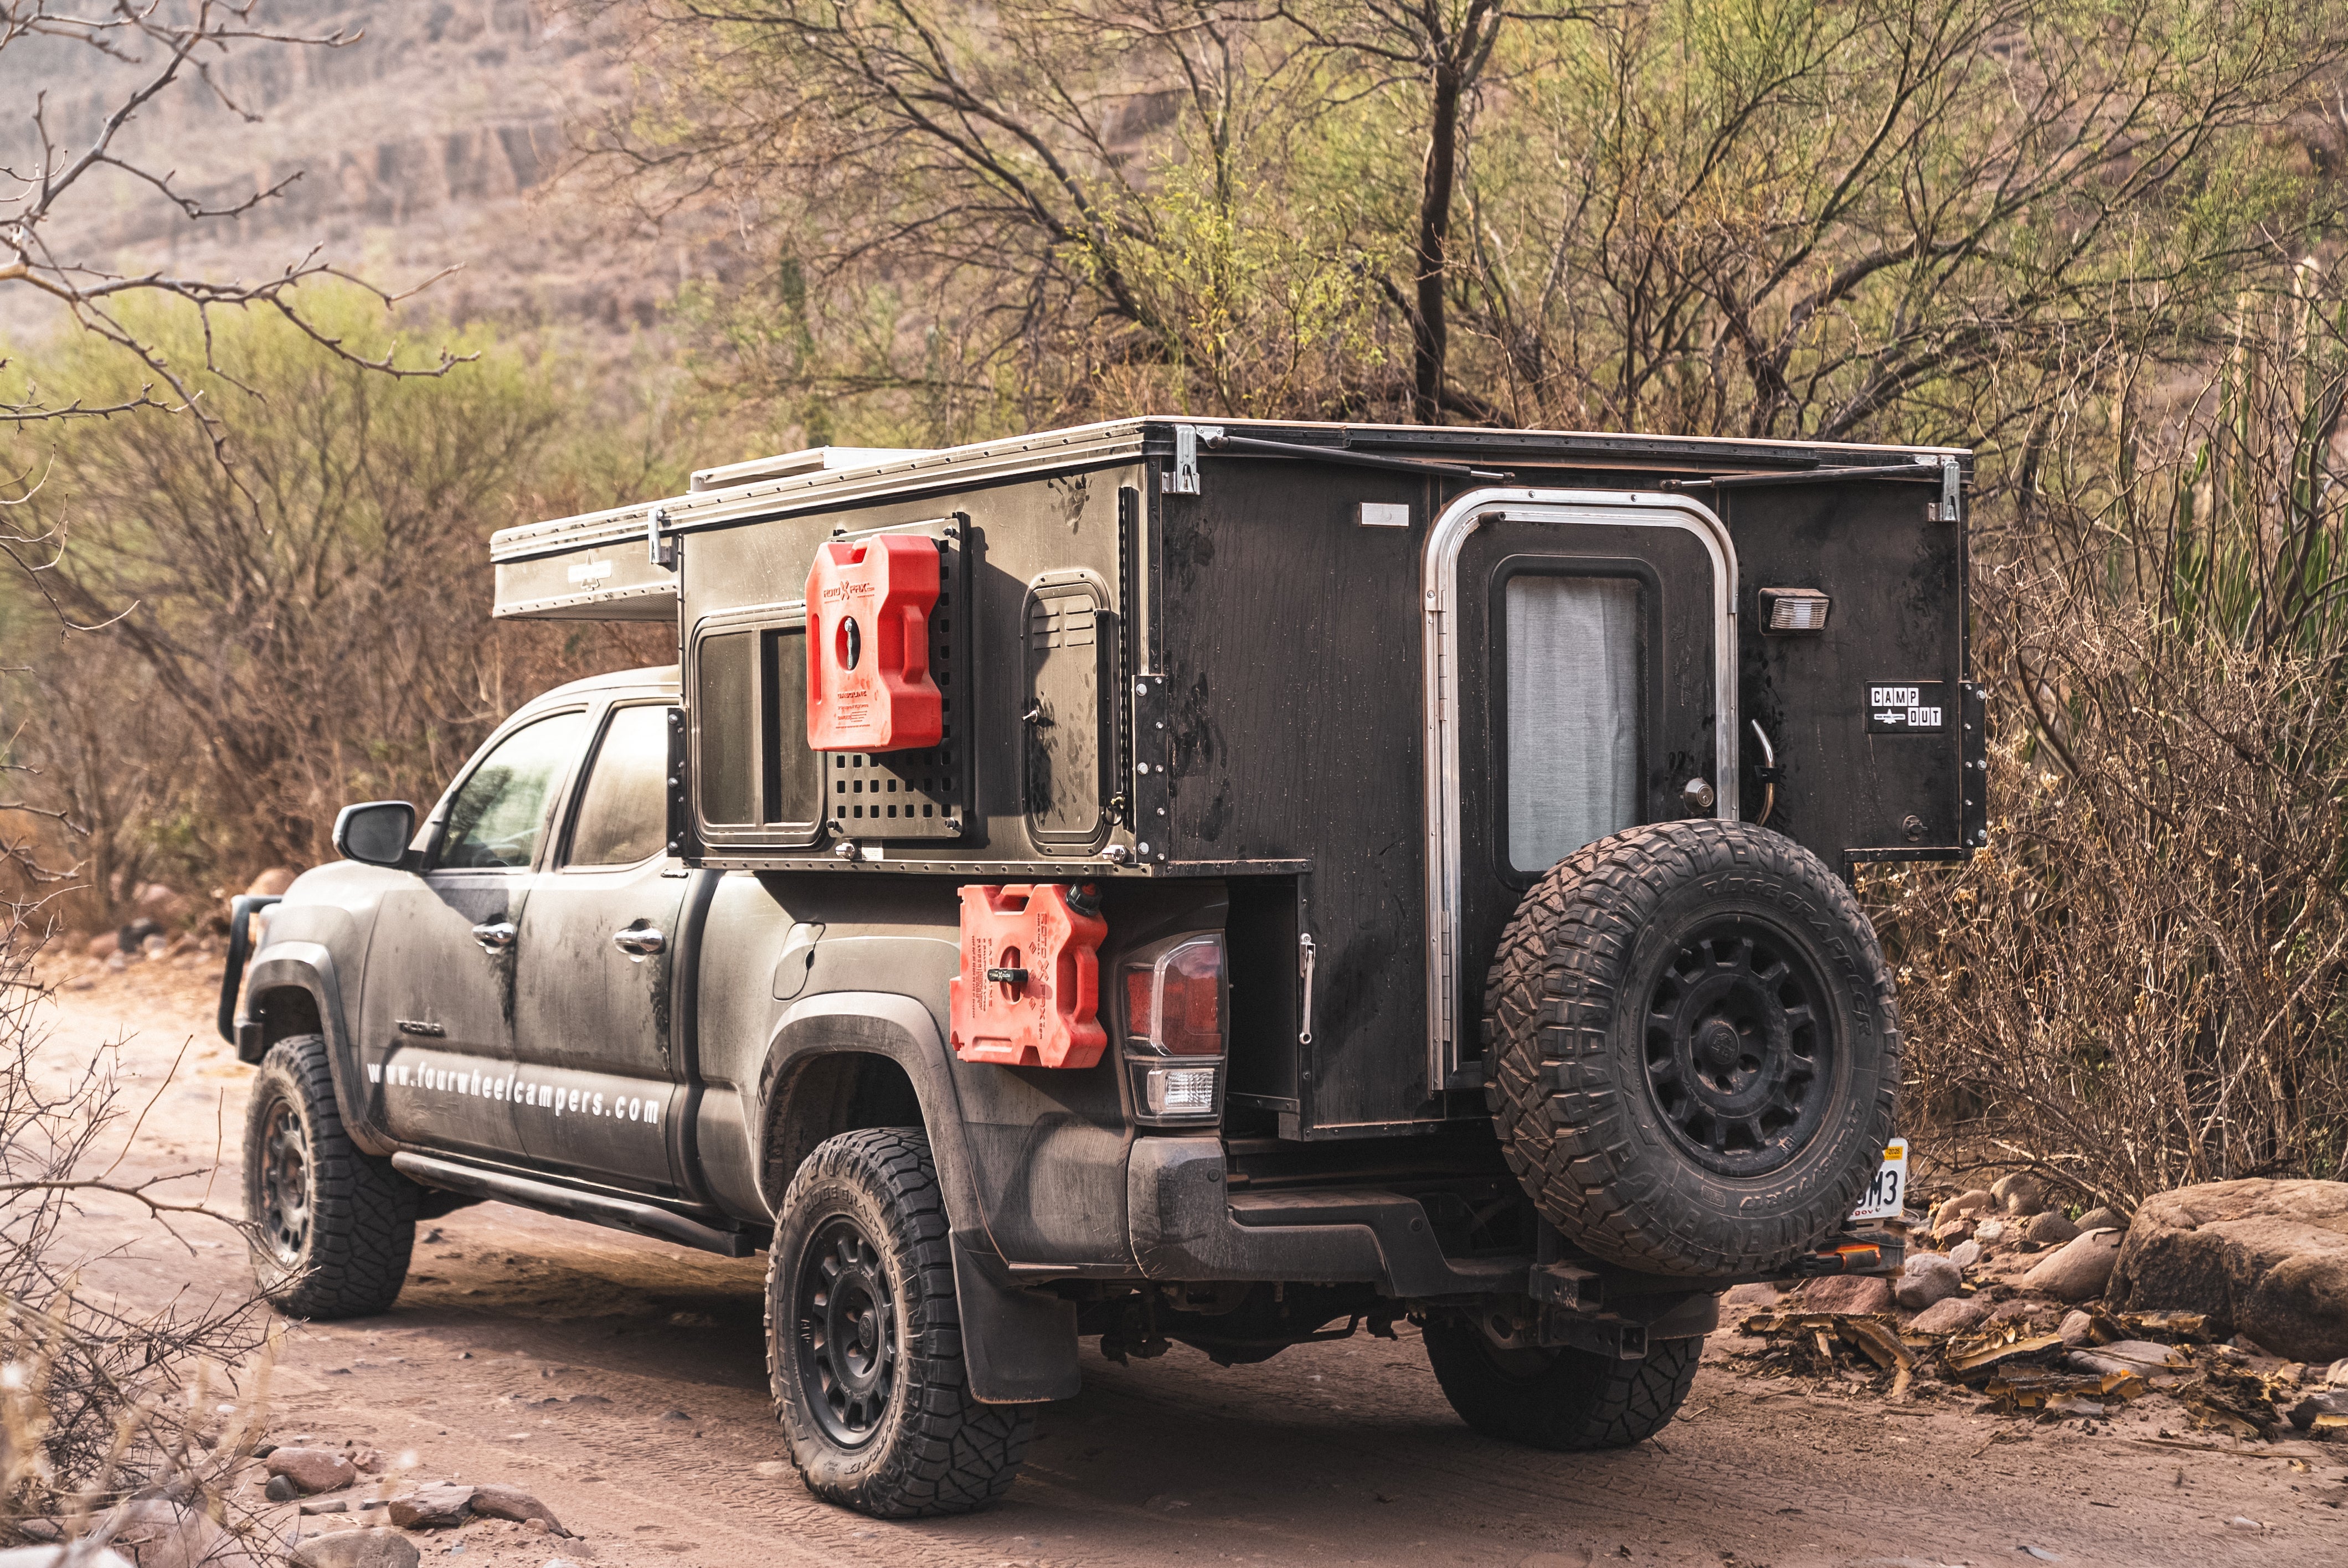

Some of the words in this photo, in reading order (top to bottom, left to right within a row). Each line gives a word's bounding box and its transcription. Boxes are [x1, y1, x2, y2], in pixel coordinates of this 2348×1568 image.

[1873, 690, 1917, 704] CAMP
[1910, 710, 1939, 724] OUT
[366, 1060, 661, 1125] www.fourwheelcampers.com
